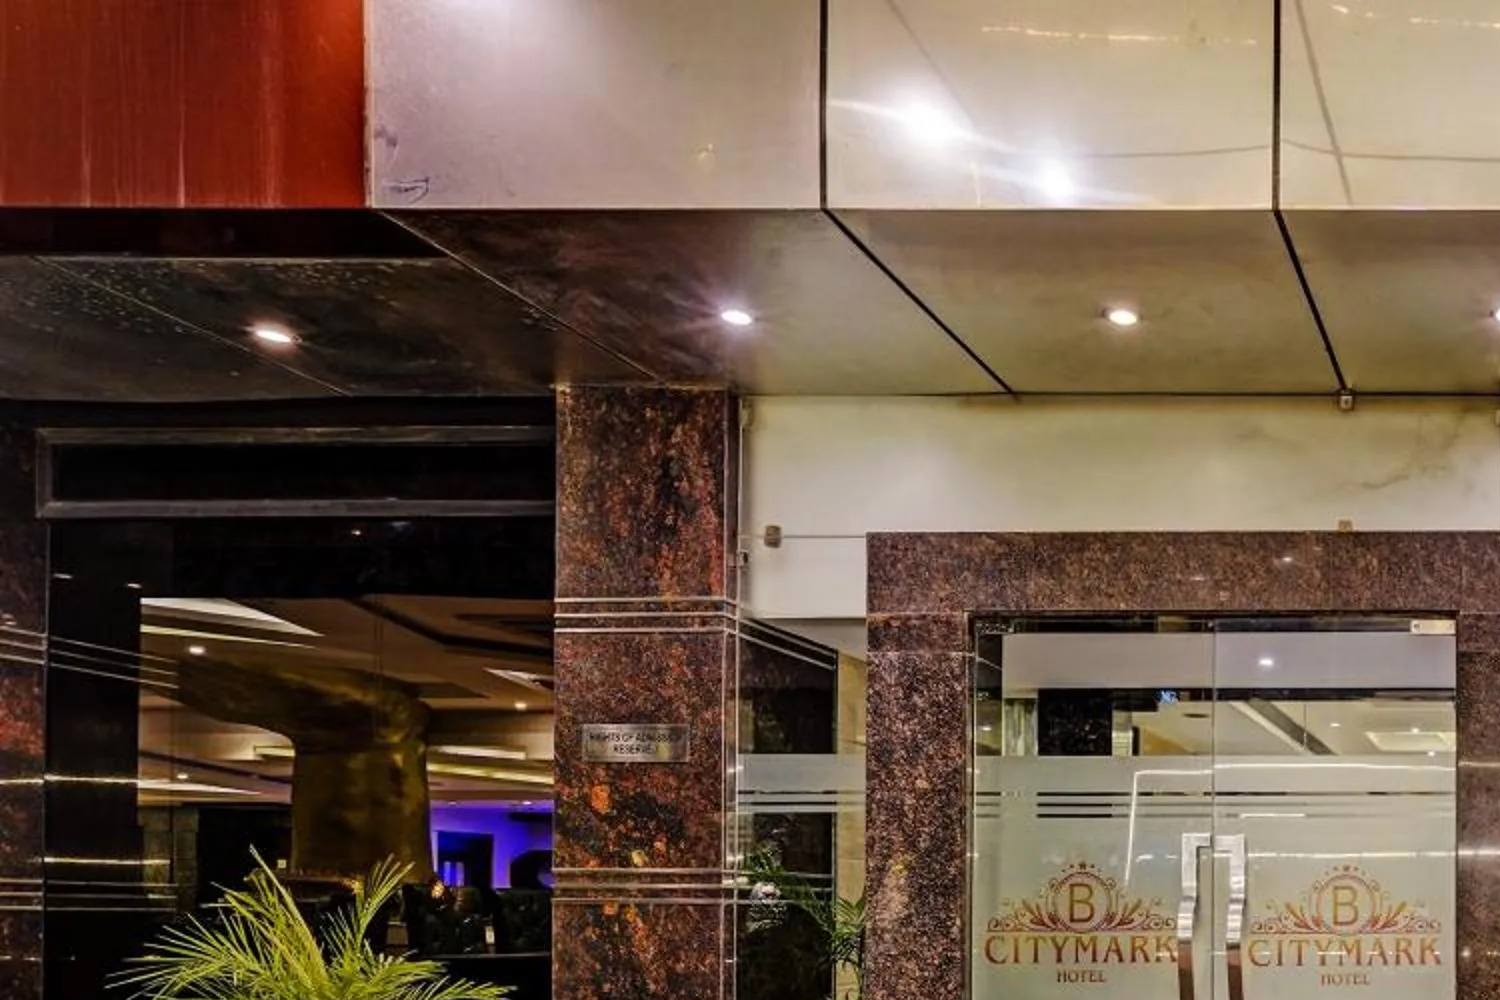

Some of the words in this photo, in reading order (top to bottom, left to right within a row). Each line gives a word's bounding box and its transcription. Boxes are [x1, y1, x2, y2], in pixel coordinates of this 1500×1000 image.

[1069, 883, 1095, 923] B
[1333, 886, 1359, 926] B
[984, 934, 1179, 965] CITYMARK
[1247, 937, 1442, 968] CITYMARK
[1056, 969, 1107, 983] HOTEL
[1320, 973, 1371, 986] HOTEL
